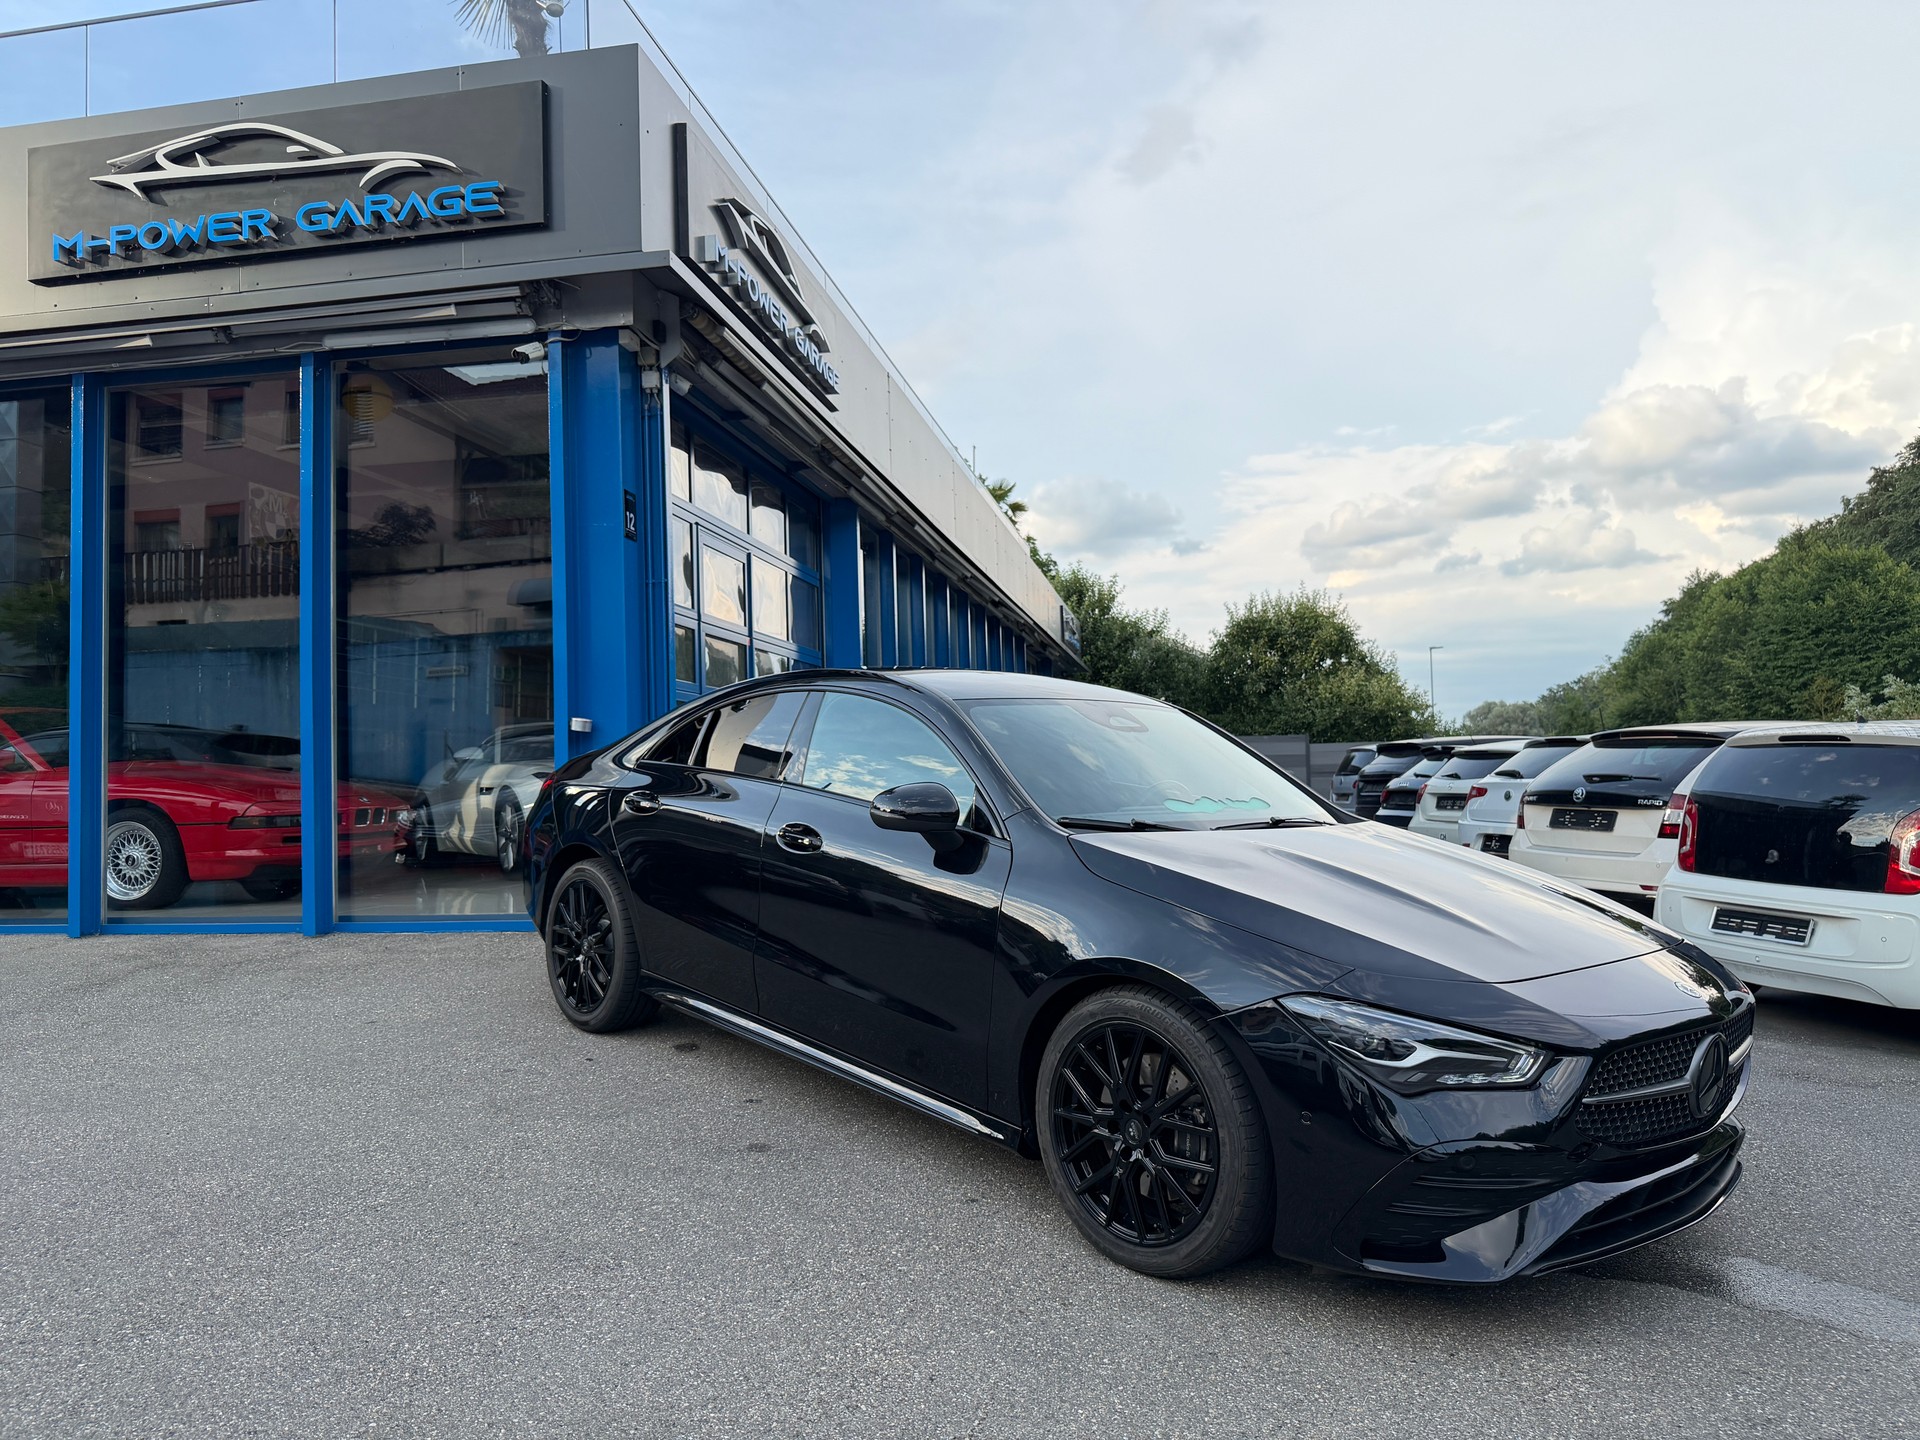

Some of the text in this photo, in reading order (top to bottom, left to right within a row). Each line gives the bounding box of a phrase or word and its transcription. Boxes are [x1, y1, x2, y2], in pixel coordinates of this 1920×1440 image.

[53, 180, 502, 263] M-POWER GARAGE
[710, 235, 840, 394] M-POWER GARAGE
[626, 511, 635, 531] 12
[1135, 1003, 1207, 1061] BRIDGESTONE
